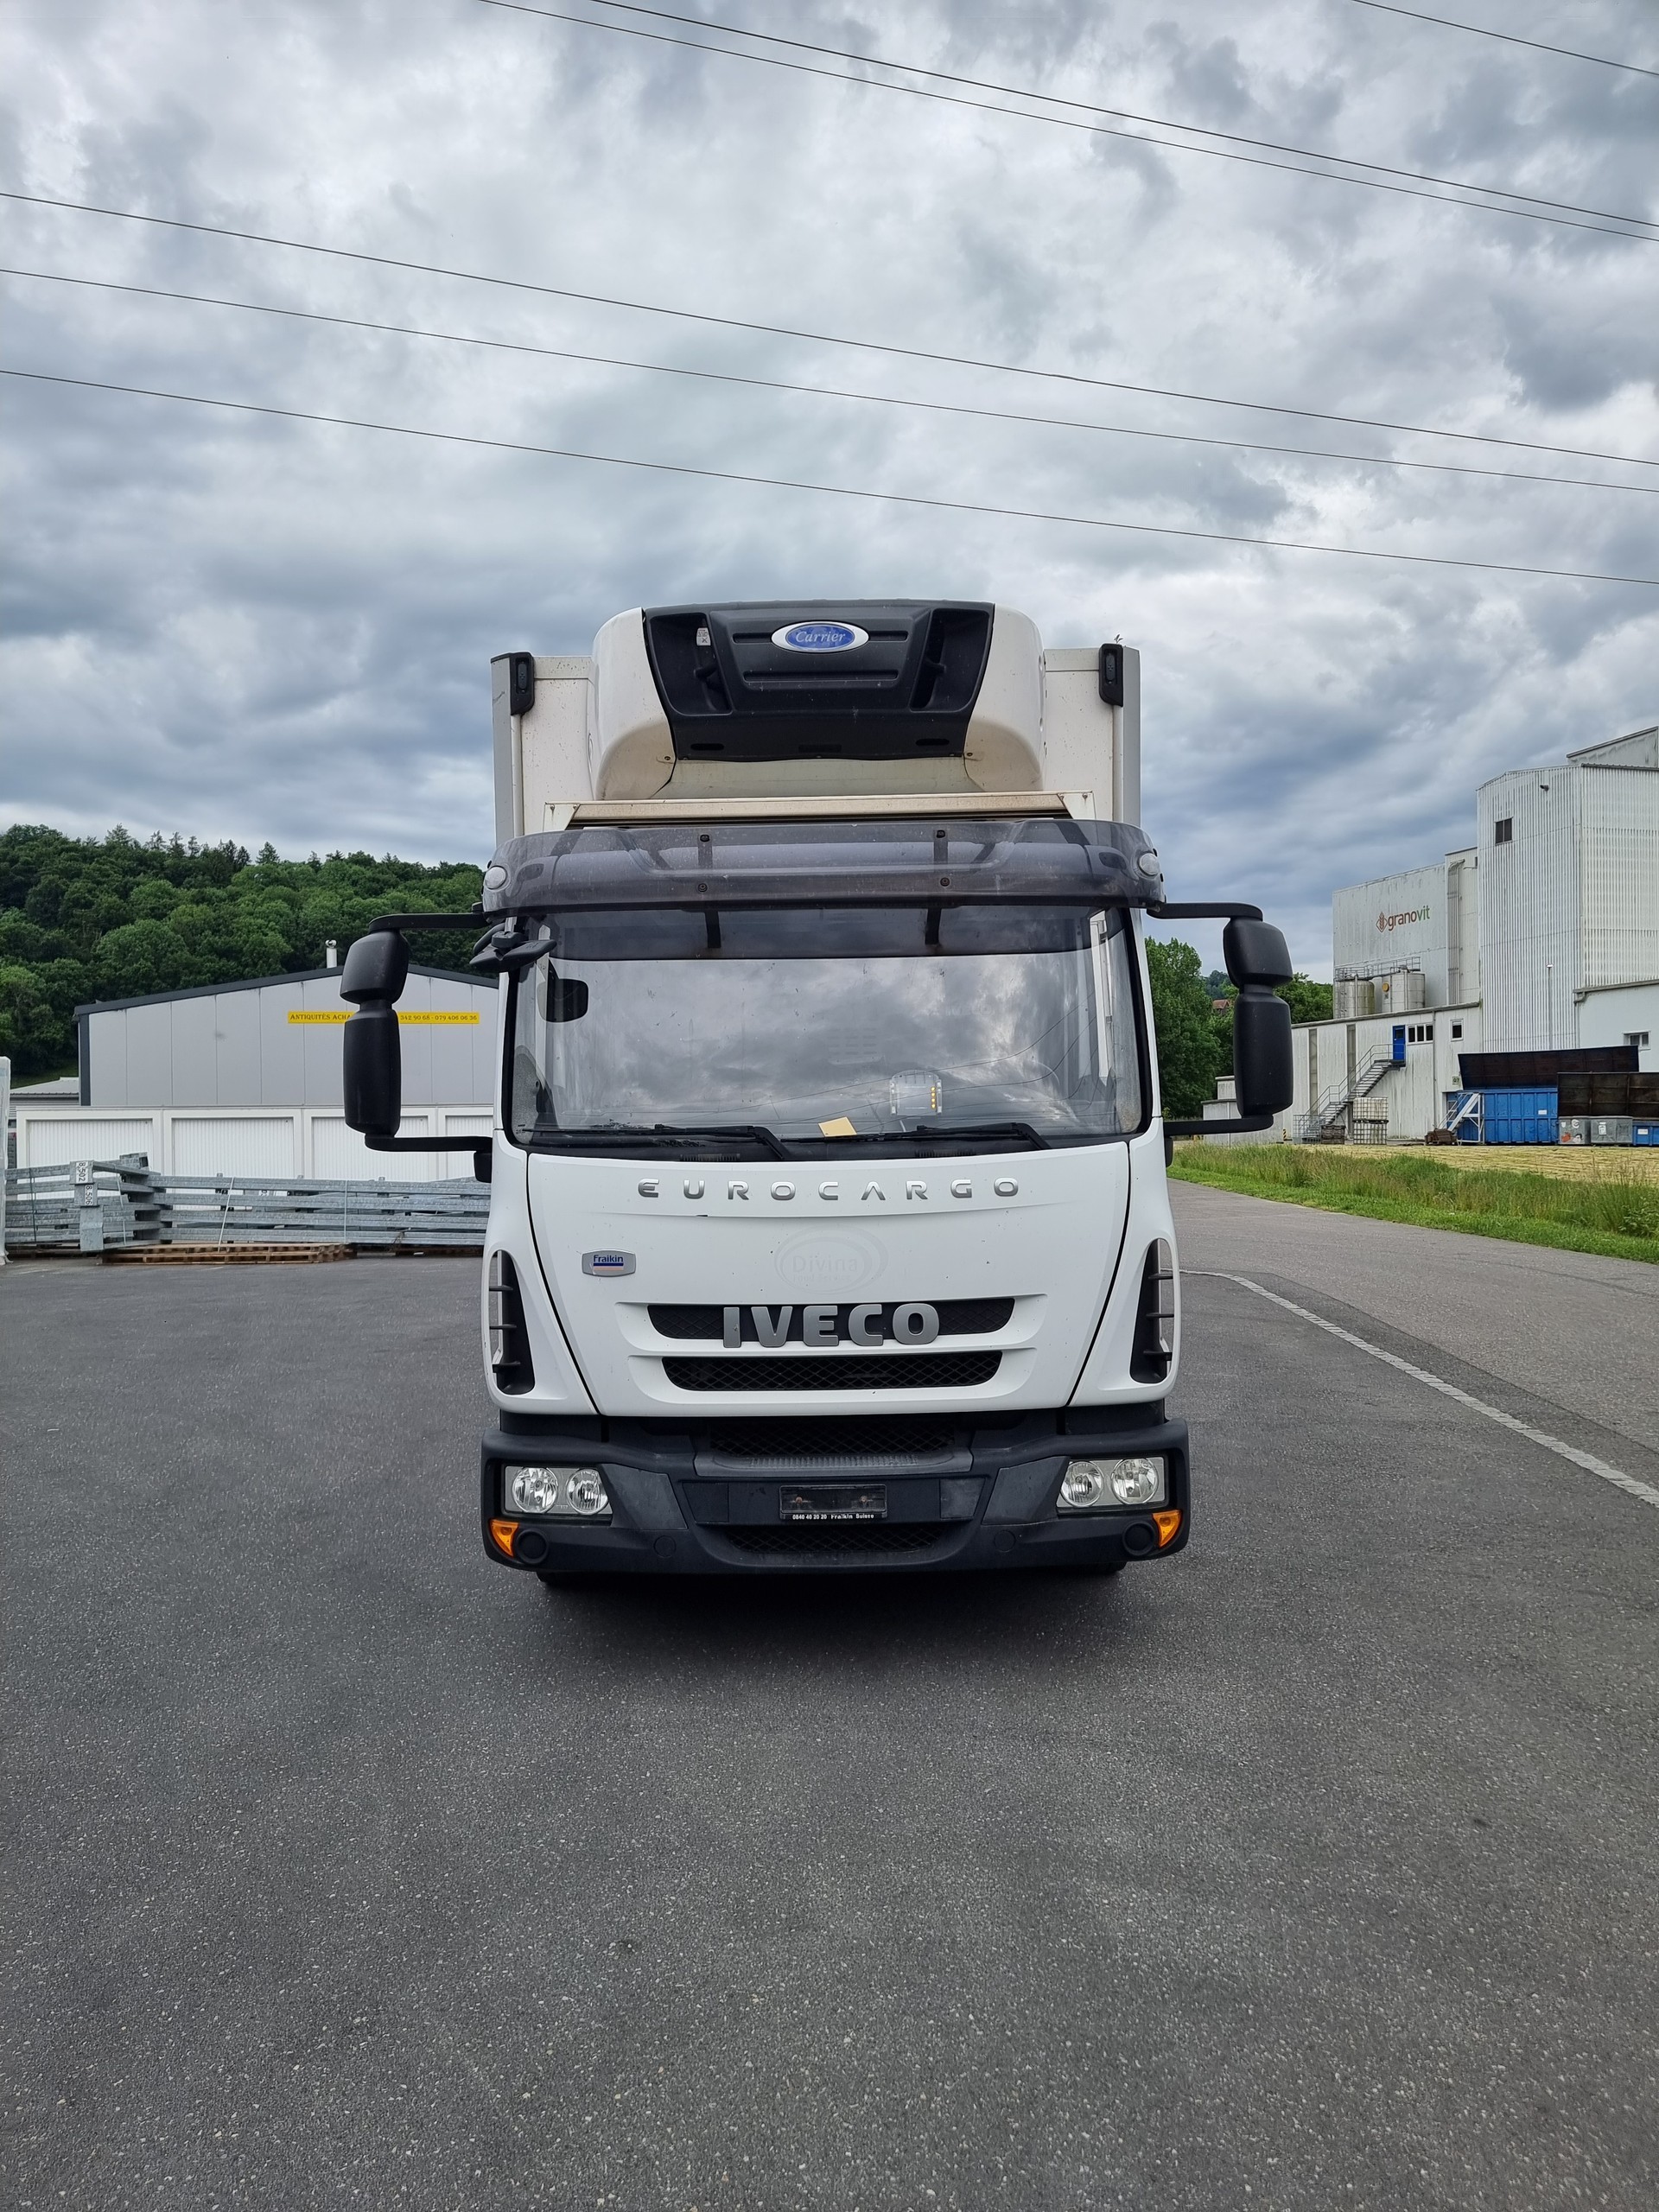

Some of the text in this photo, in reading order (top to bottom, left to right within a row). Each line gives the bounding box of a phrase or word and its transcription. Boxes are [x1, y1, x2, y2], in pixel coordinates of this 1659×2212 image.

[796, 632, 846, 643] Carrier
[1388, 906, 1430, 931] granovit
[638, 1177, 1019, 1200] EUROCARGO
[792, 1255, 857, 1273] Divina
[723, 1303, 939, 1348] IVECO
